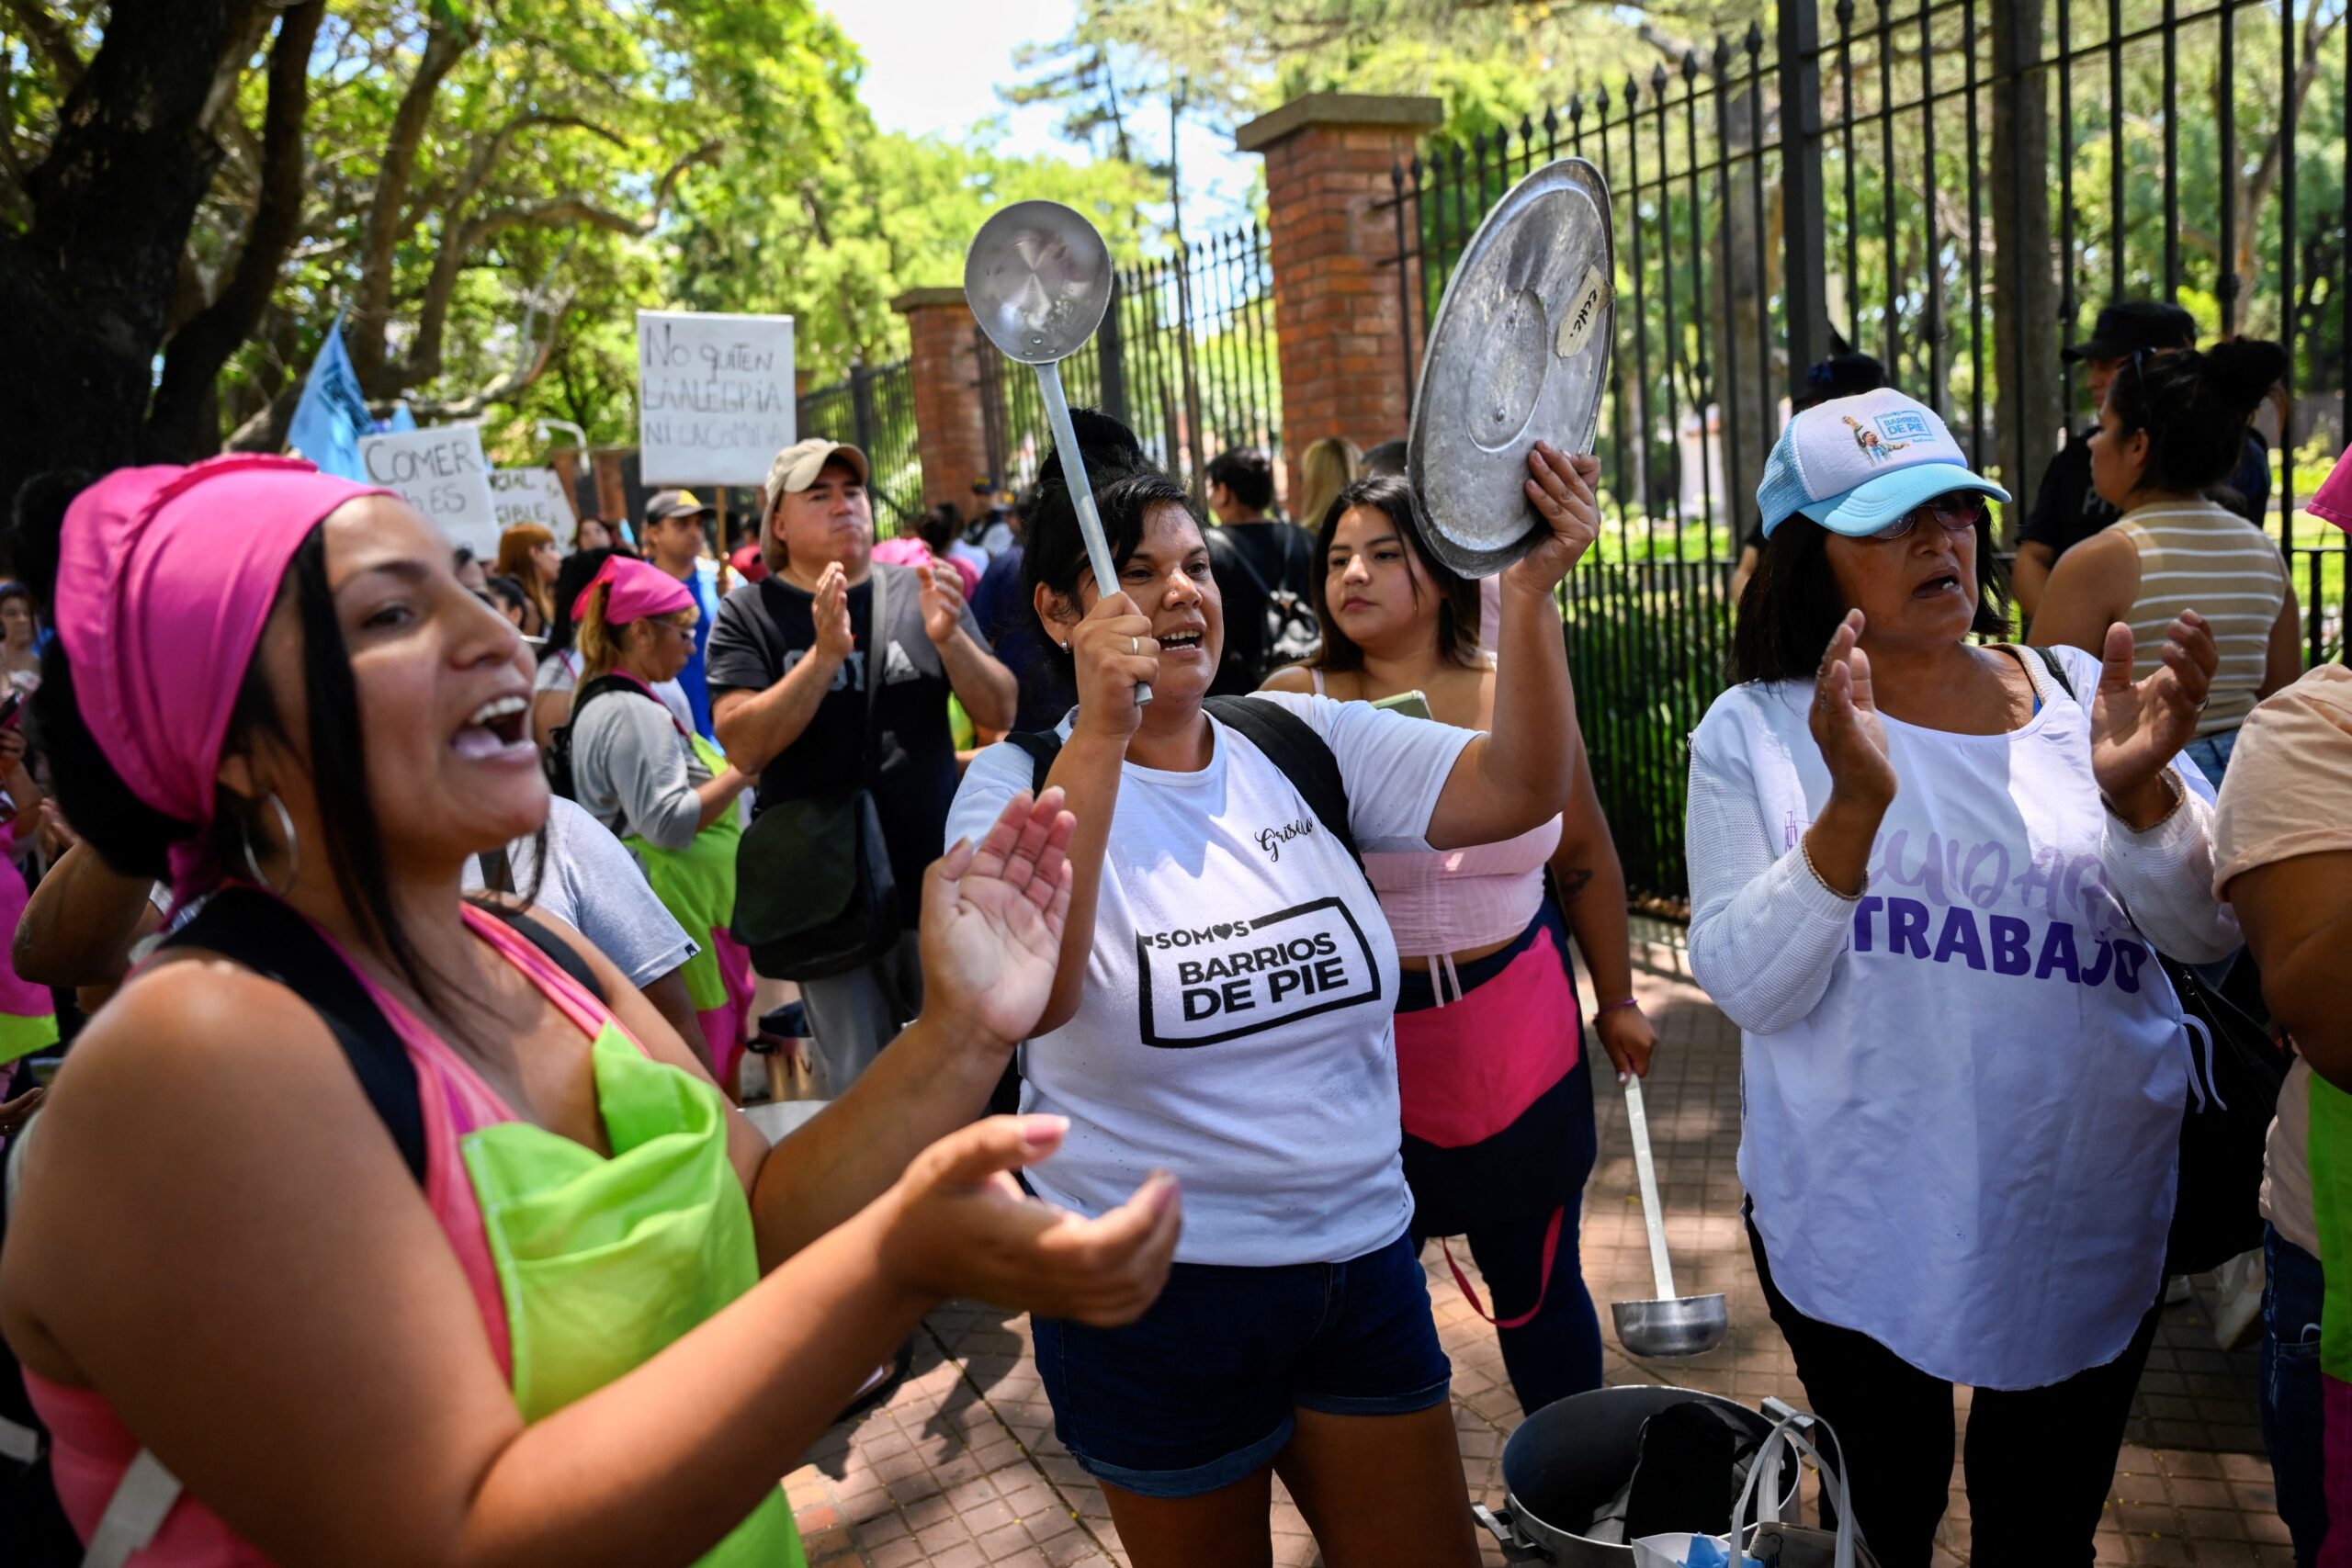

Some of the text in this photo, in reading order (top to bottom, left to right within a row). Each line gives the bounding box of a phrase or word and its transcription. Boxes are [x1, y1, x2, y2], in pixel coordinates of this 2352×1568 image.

[1883, 416, 1921, 426] BARRIOS
[1887, 423, 1925, 434] DE PIE
[365, 438, 483, 486] COMER
[429, 481, 467, 514] ES
[1178, 932, 1337, 986] BARRIOS
[1854, 896, 2148, 994] TRABAJO
[1182, 956, 1349, 1021] DE PIE
